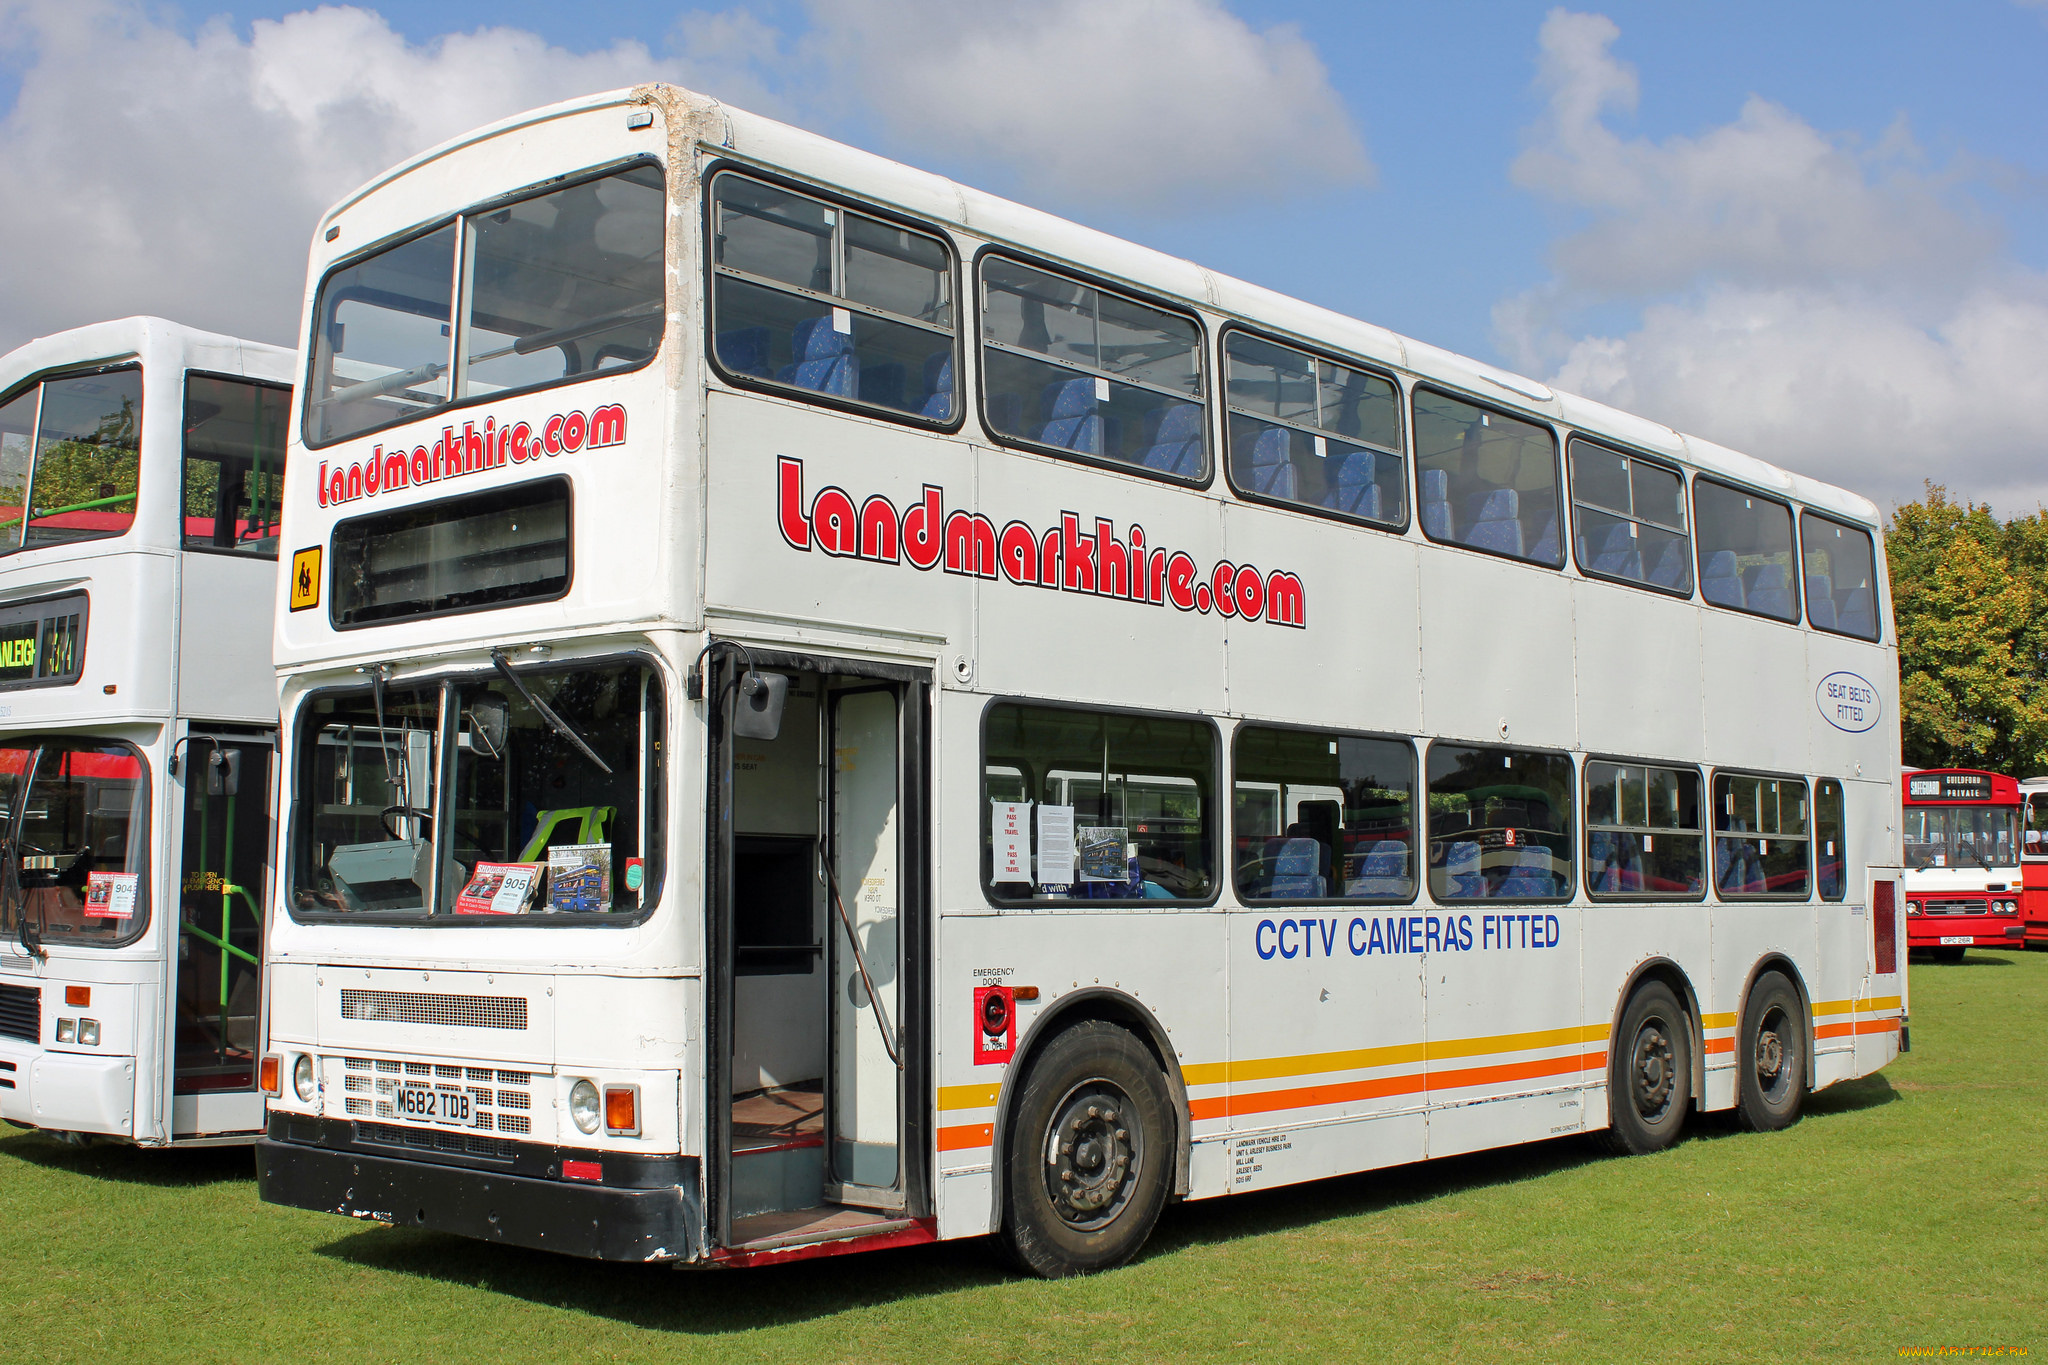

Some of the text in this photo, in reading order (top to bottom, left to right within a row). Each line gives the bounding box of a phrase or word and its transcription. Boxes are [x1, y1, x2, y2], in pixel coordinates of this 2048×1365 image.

[318, 403, 627, 509] Landmarkhire.com
[777, 455, 1306, 630] Landmarkhire.com
[1827, 682, 1871, 704] SEAT BELTS
[1837, 704, 1863, 722] FITTED
[1946, 776, 1982, 785] GUILDFORD
[1911, 780, 1940, 795] SAFEGUARD
[1946, 789, 1980, 798] PRIVATE
[116, 883, 133, 893] 904
[504, 877, 526, 890] 905
[1048, 883, 1067, 893] with
[1256, 914, 1560, 960] CCTV CAMERAS FITTED
[973, 968, 1015, 977] EMERGENCY
[983, 978, 1003, 986] DOOR
[983, 1042, 1007, 1051] TO OPEN
[397, 1088, 469, 1120] M682 TDB
[1236, 1139, 1256, 1148] LANDMARK
[1266, 1144, 1282, 1152] BUSINESS
